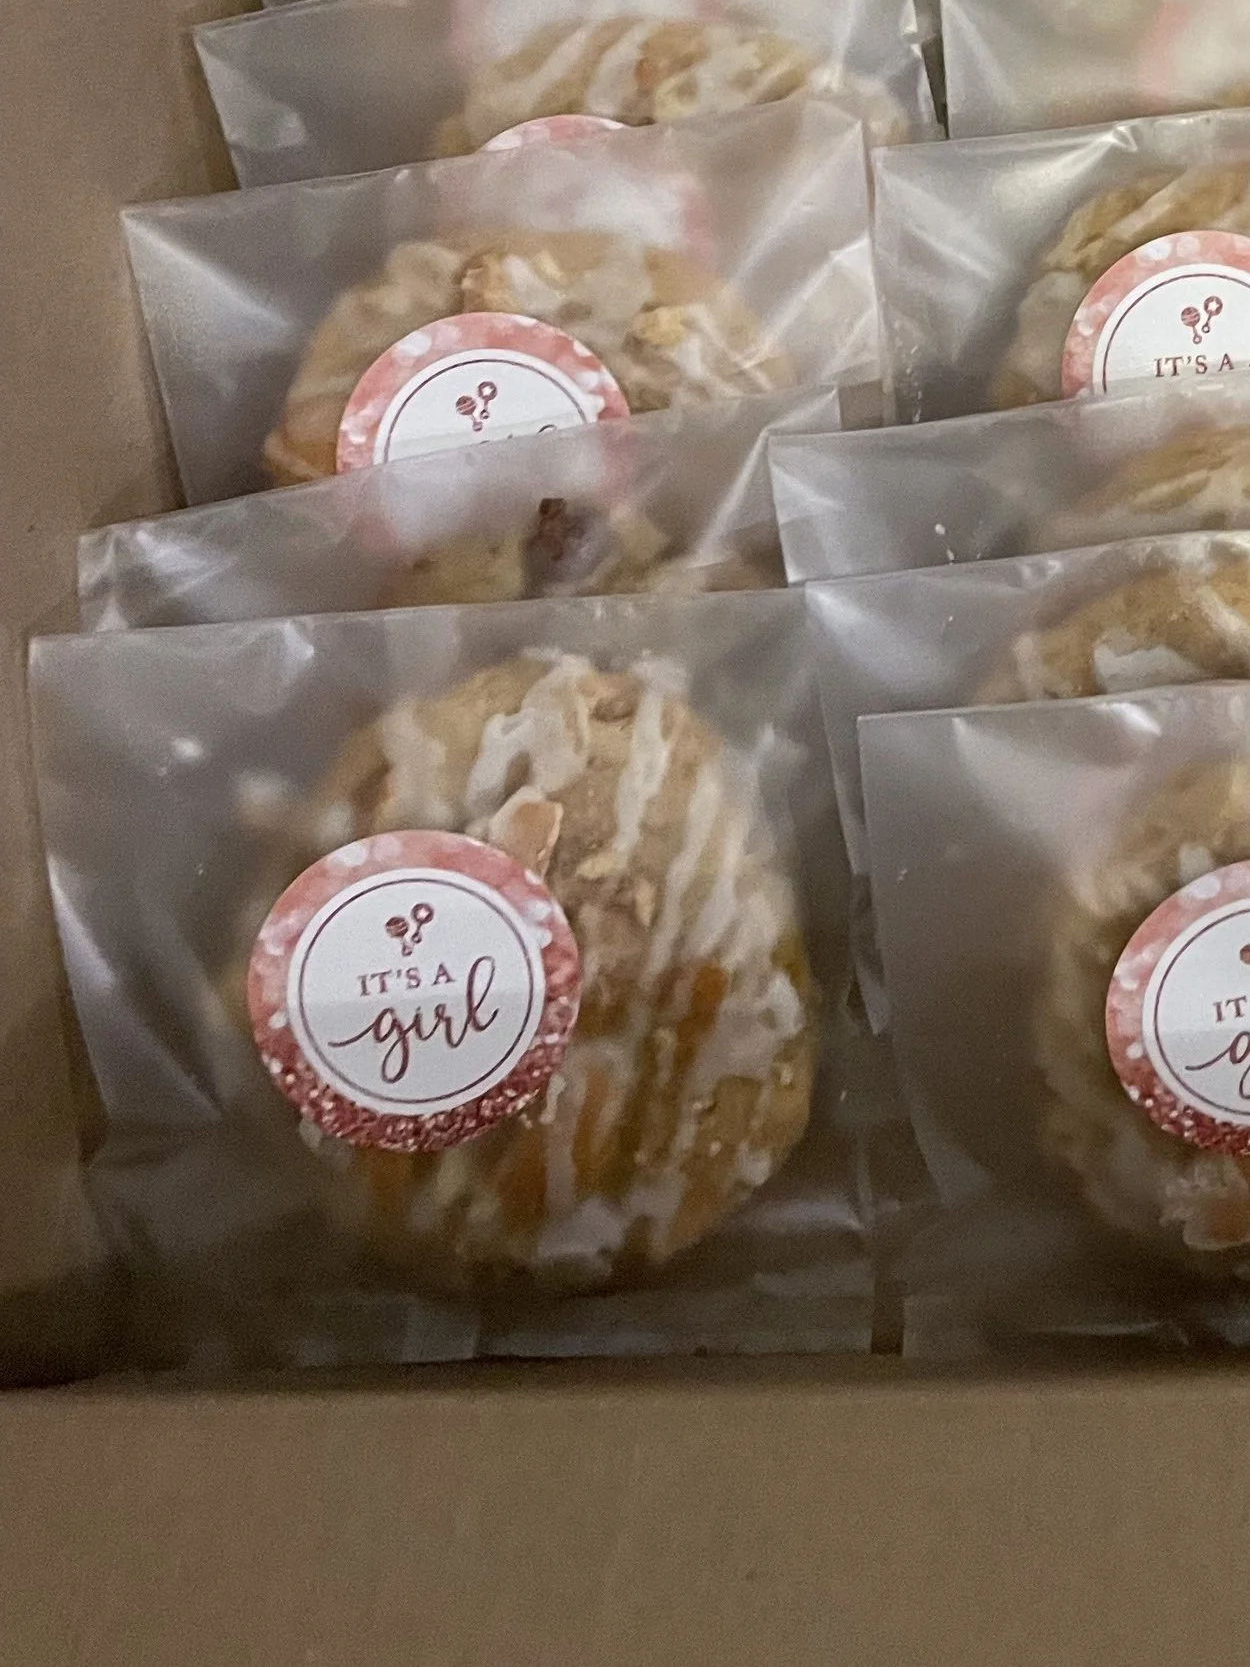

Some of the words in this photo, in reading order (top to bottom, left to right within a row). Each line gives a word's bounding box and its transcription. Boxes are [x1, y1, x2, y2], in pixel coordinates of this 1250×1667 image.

[1153, 354, 1208, 378] IT'S
[1217, 352, 1236, 372] A
[357, 966, 421, 997] IT'S
[432, 962, 456, 986] A
[327, 955, 499, 1084] girl
